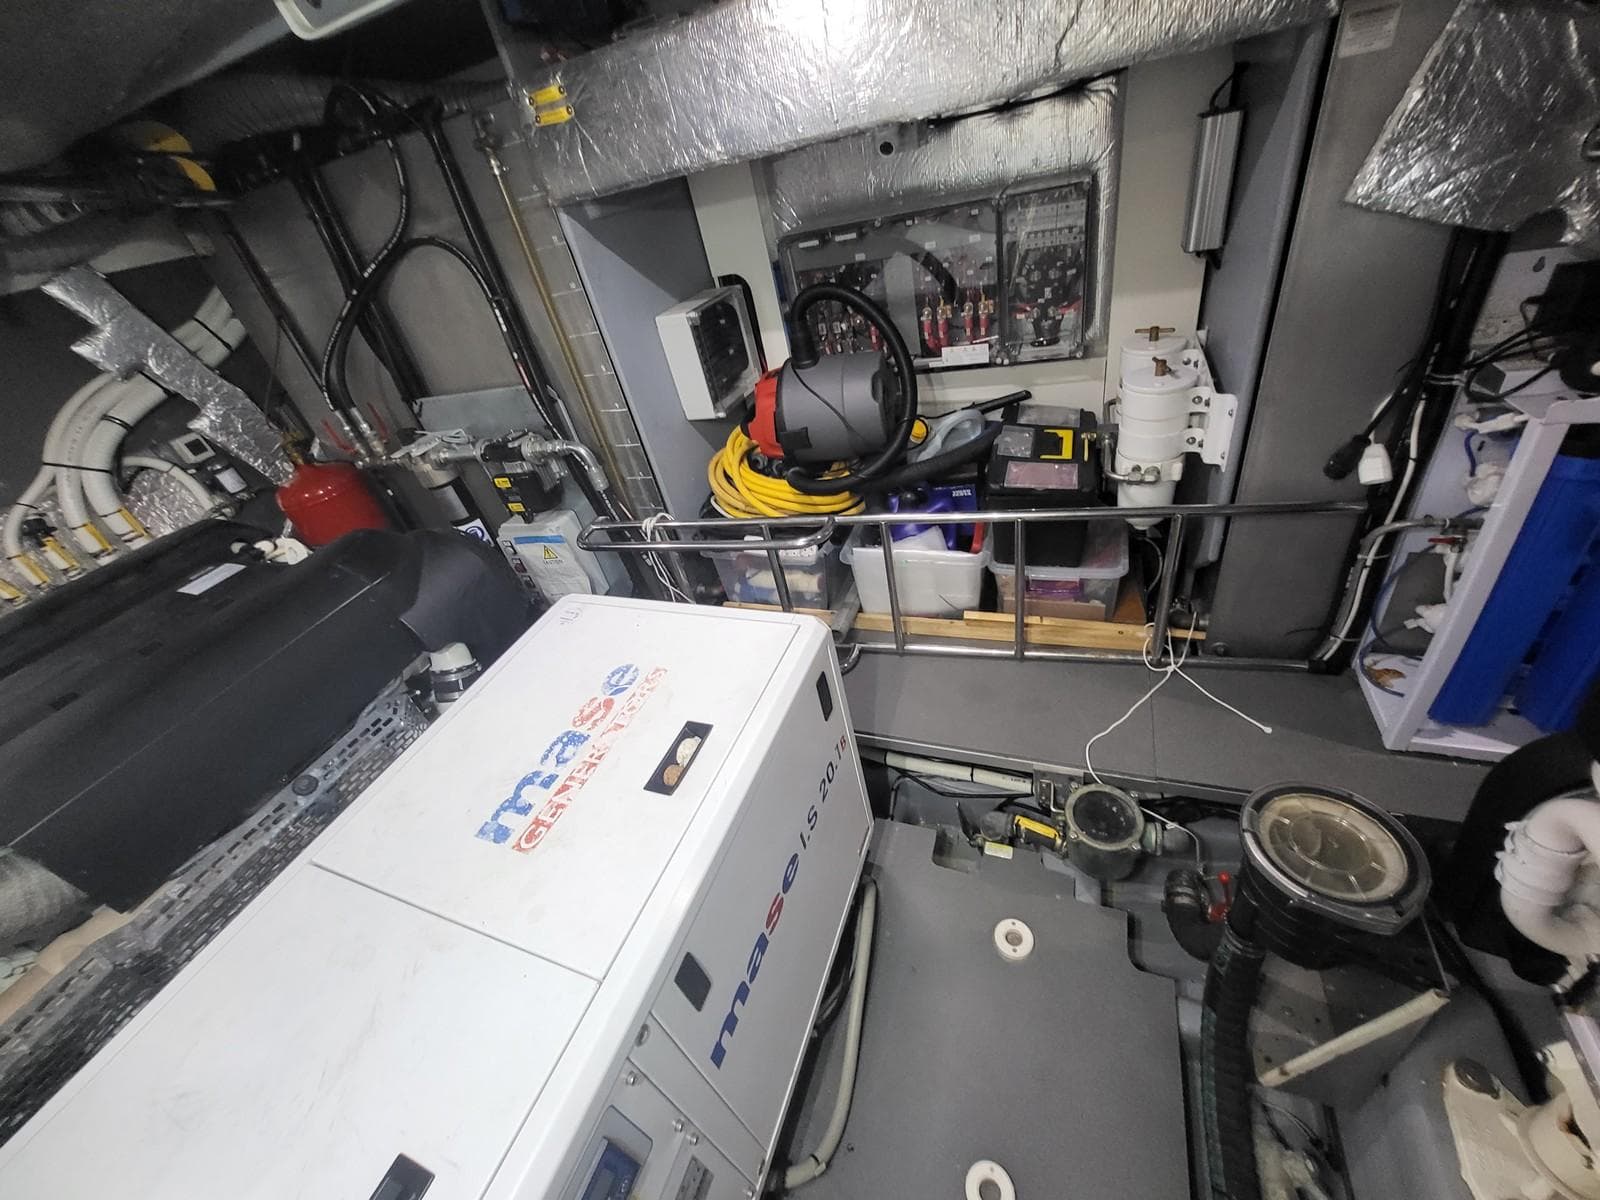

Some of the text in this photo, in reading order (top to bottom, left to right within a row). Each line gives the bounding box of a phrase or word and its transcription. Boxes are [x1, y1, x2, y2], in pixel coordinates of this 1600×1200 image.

[474, 663, 640, 844] mase
[512, 666, 668, 852] GENERTORS
[710, 852, 800, 1070] mase
